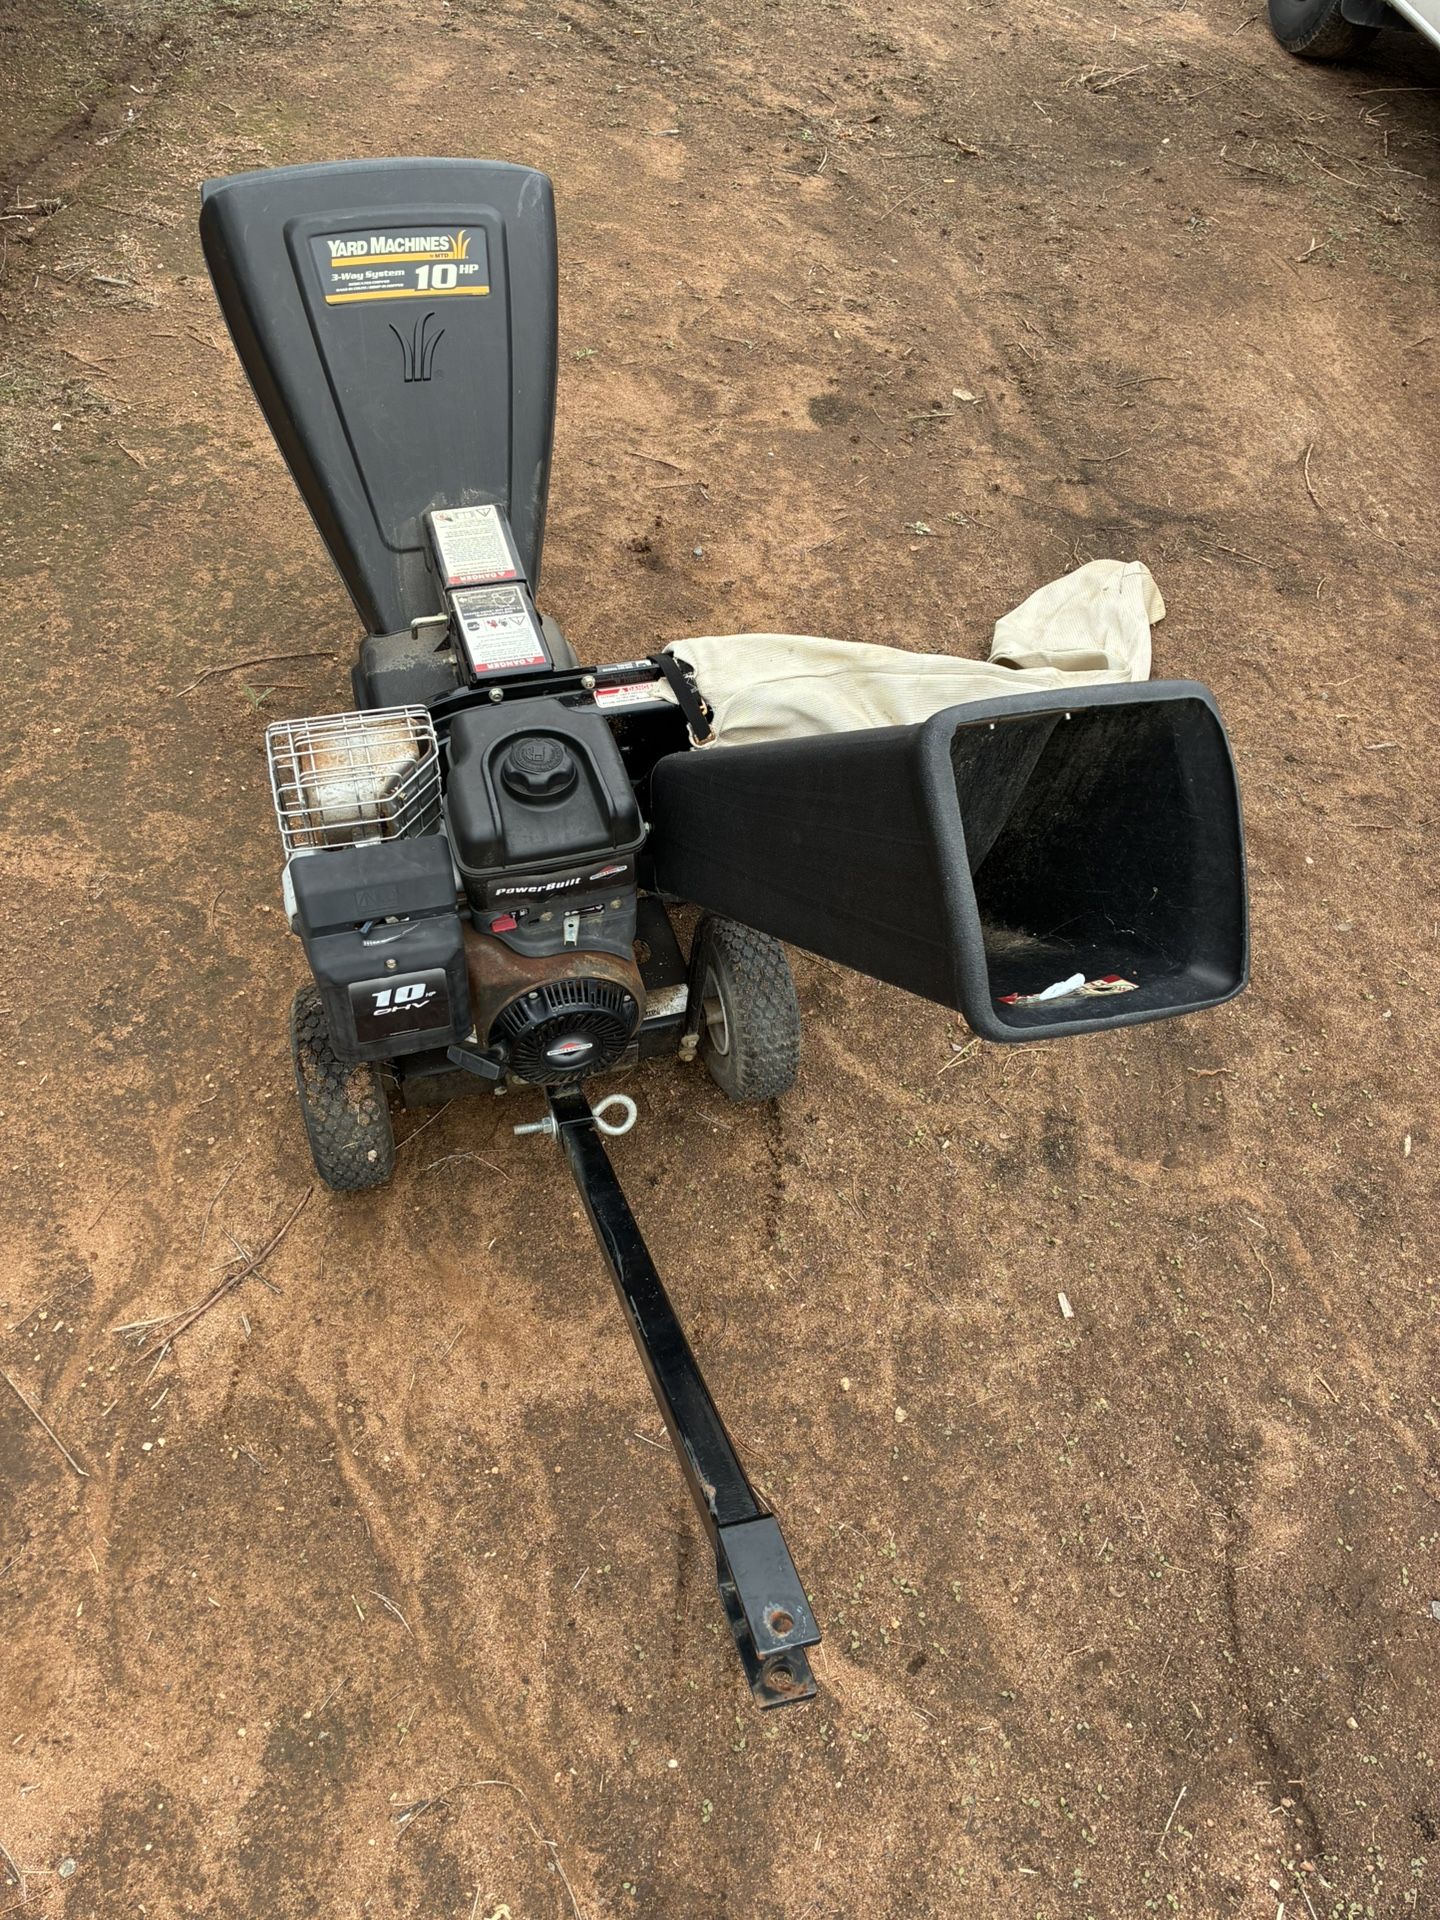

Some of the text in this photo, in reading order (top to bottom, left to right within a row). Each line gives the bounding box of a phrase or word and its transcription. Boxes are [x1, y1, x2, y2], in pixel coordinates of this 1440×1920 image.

[327, 236, 450, 257] YARD MACHINES
[331, 269, 405, 282] 3-Way System
[415, 263, 458, 290] 10
[459, 264, 480, 274] HP
[487, 658, 526, 669] DANGER
[495, 877, 581, 896] PowerBuilt
[371, 983, 427, 1008] 10
[373, 1000, 430, 1016] OHV
